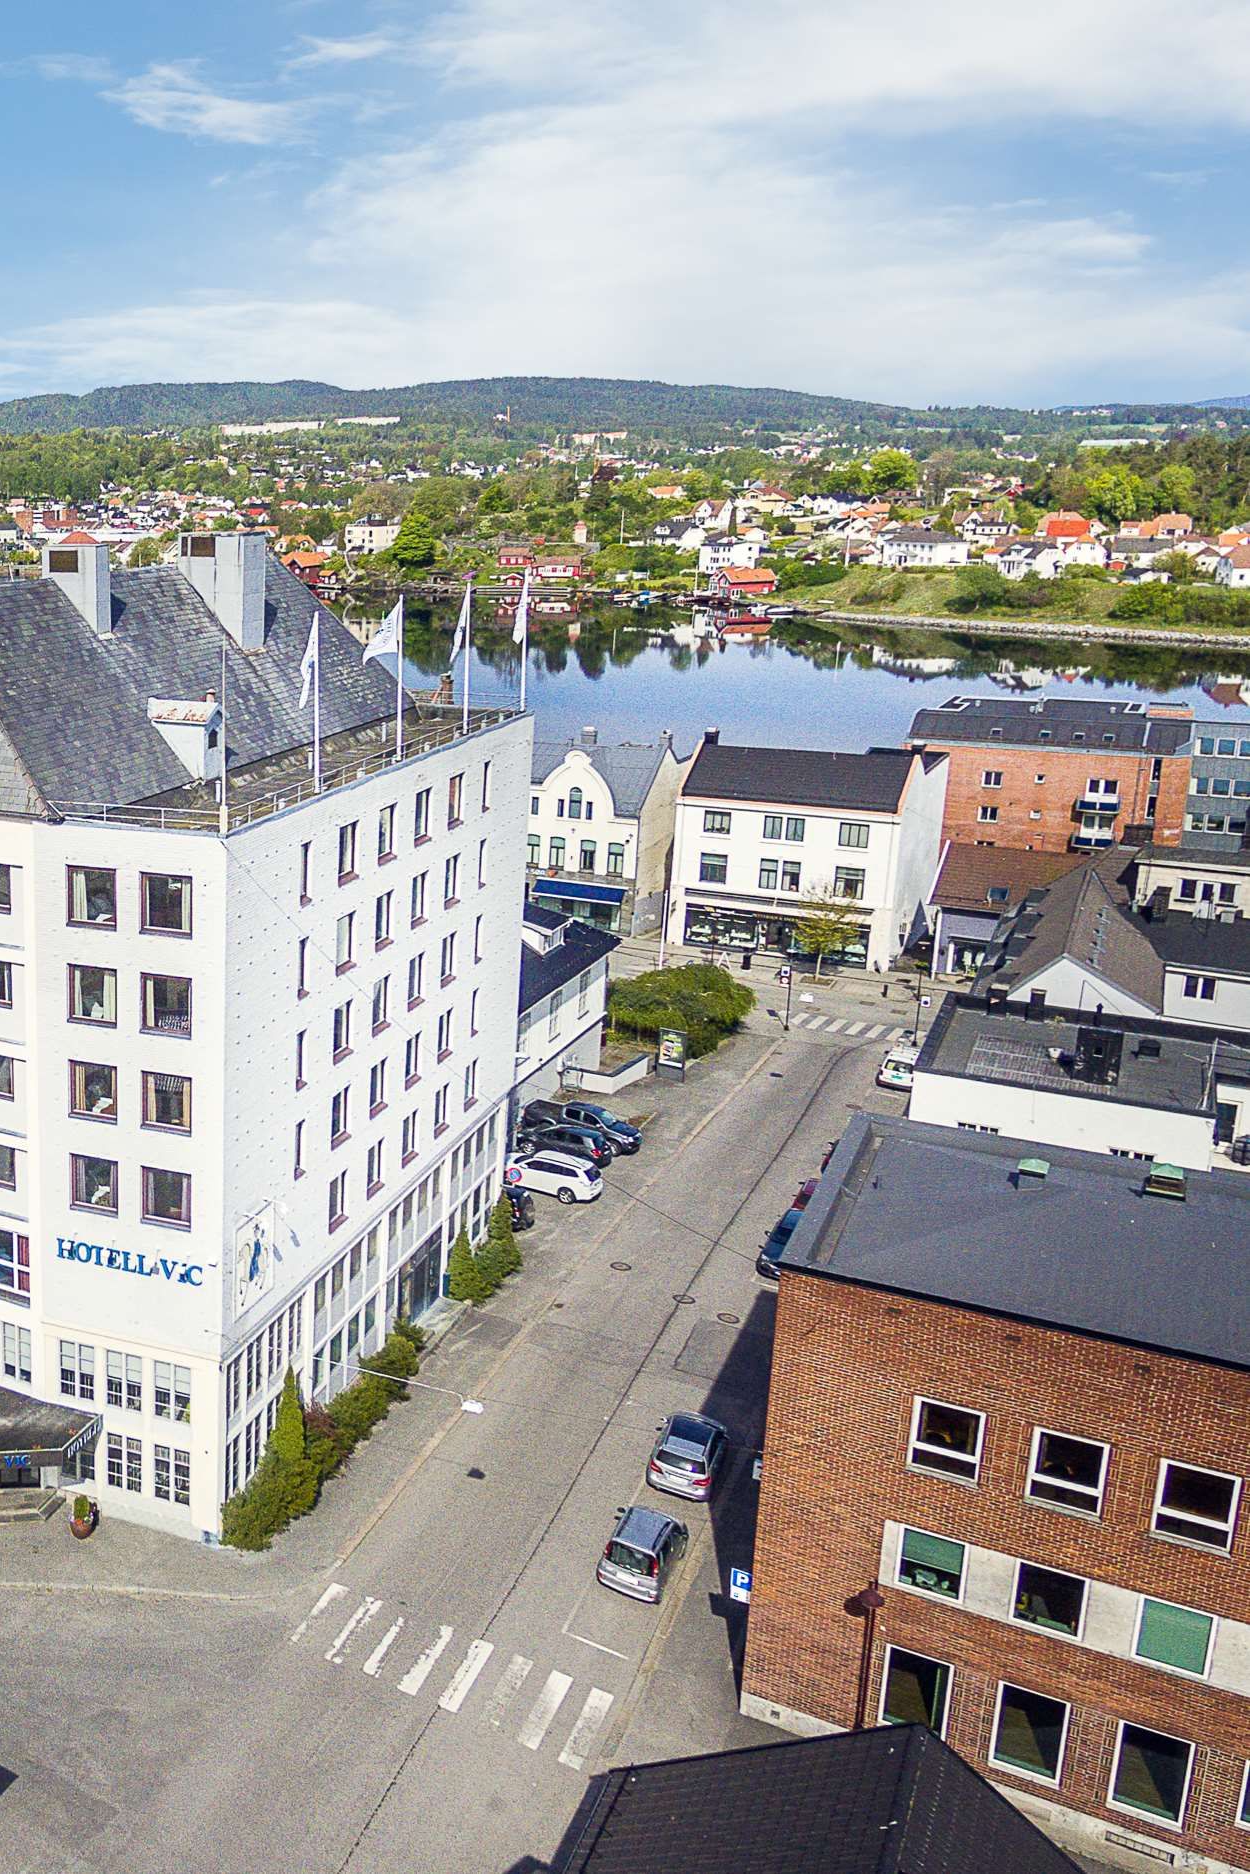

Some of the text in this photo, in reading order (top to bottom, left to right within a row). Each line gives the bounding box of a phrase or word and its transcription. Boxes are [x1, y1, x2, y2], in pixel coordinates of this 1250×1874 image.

[56, 1237, 203, 1286] HOTELL VIC
[4, 1455, 31, 1468] VIC
[736, 1572, 749, 1587] P
